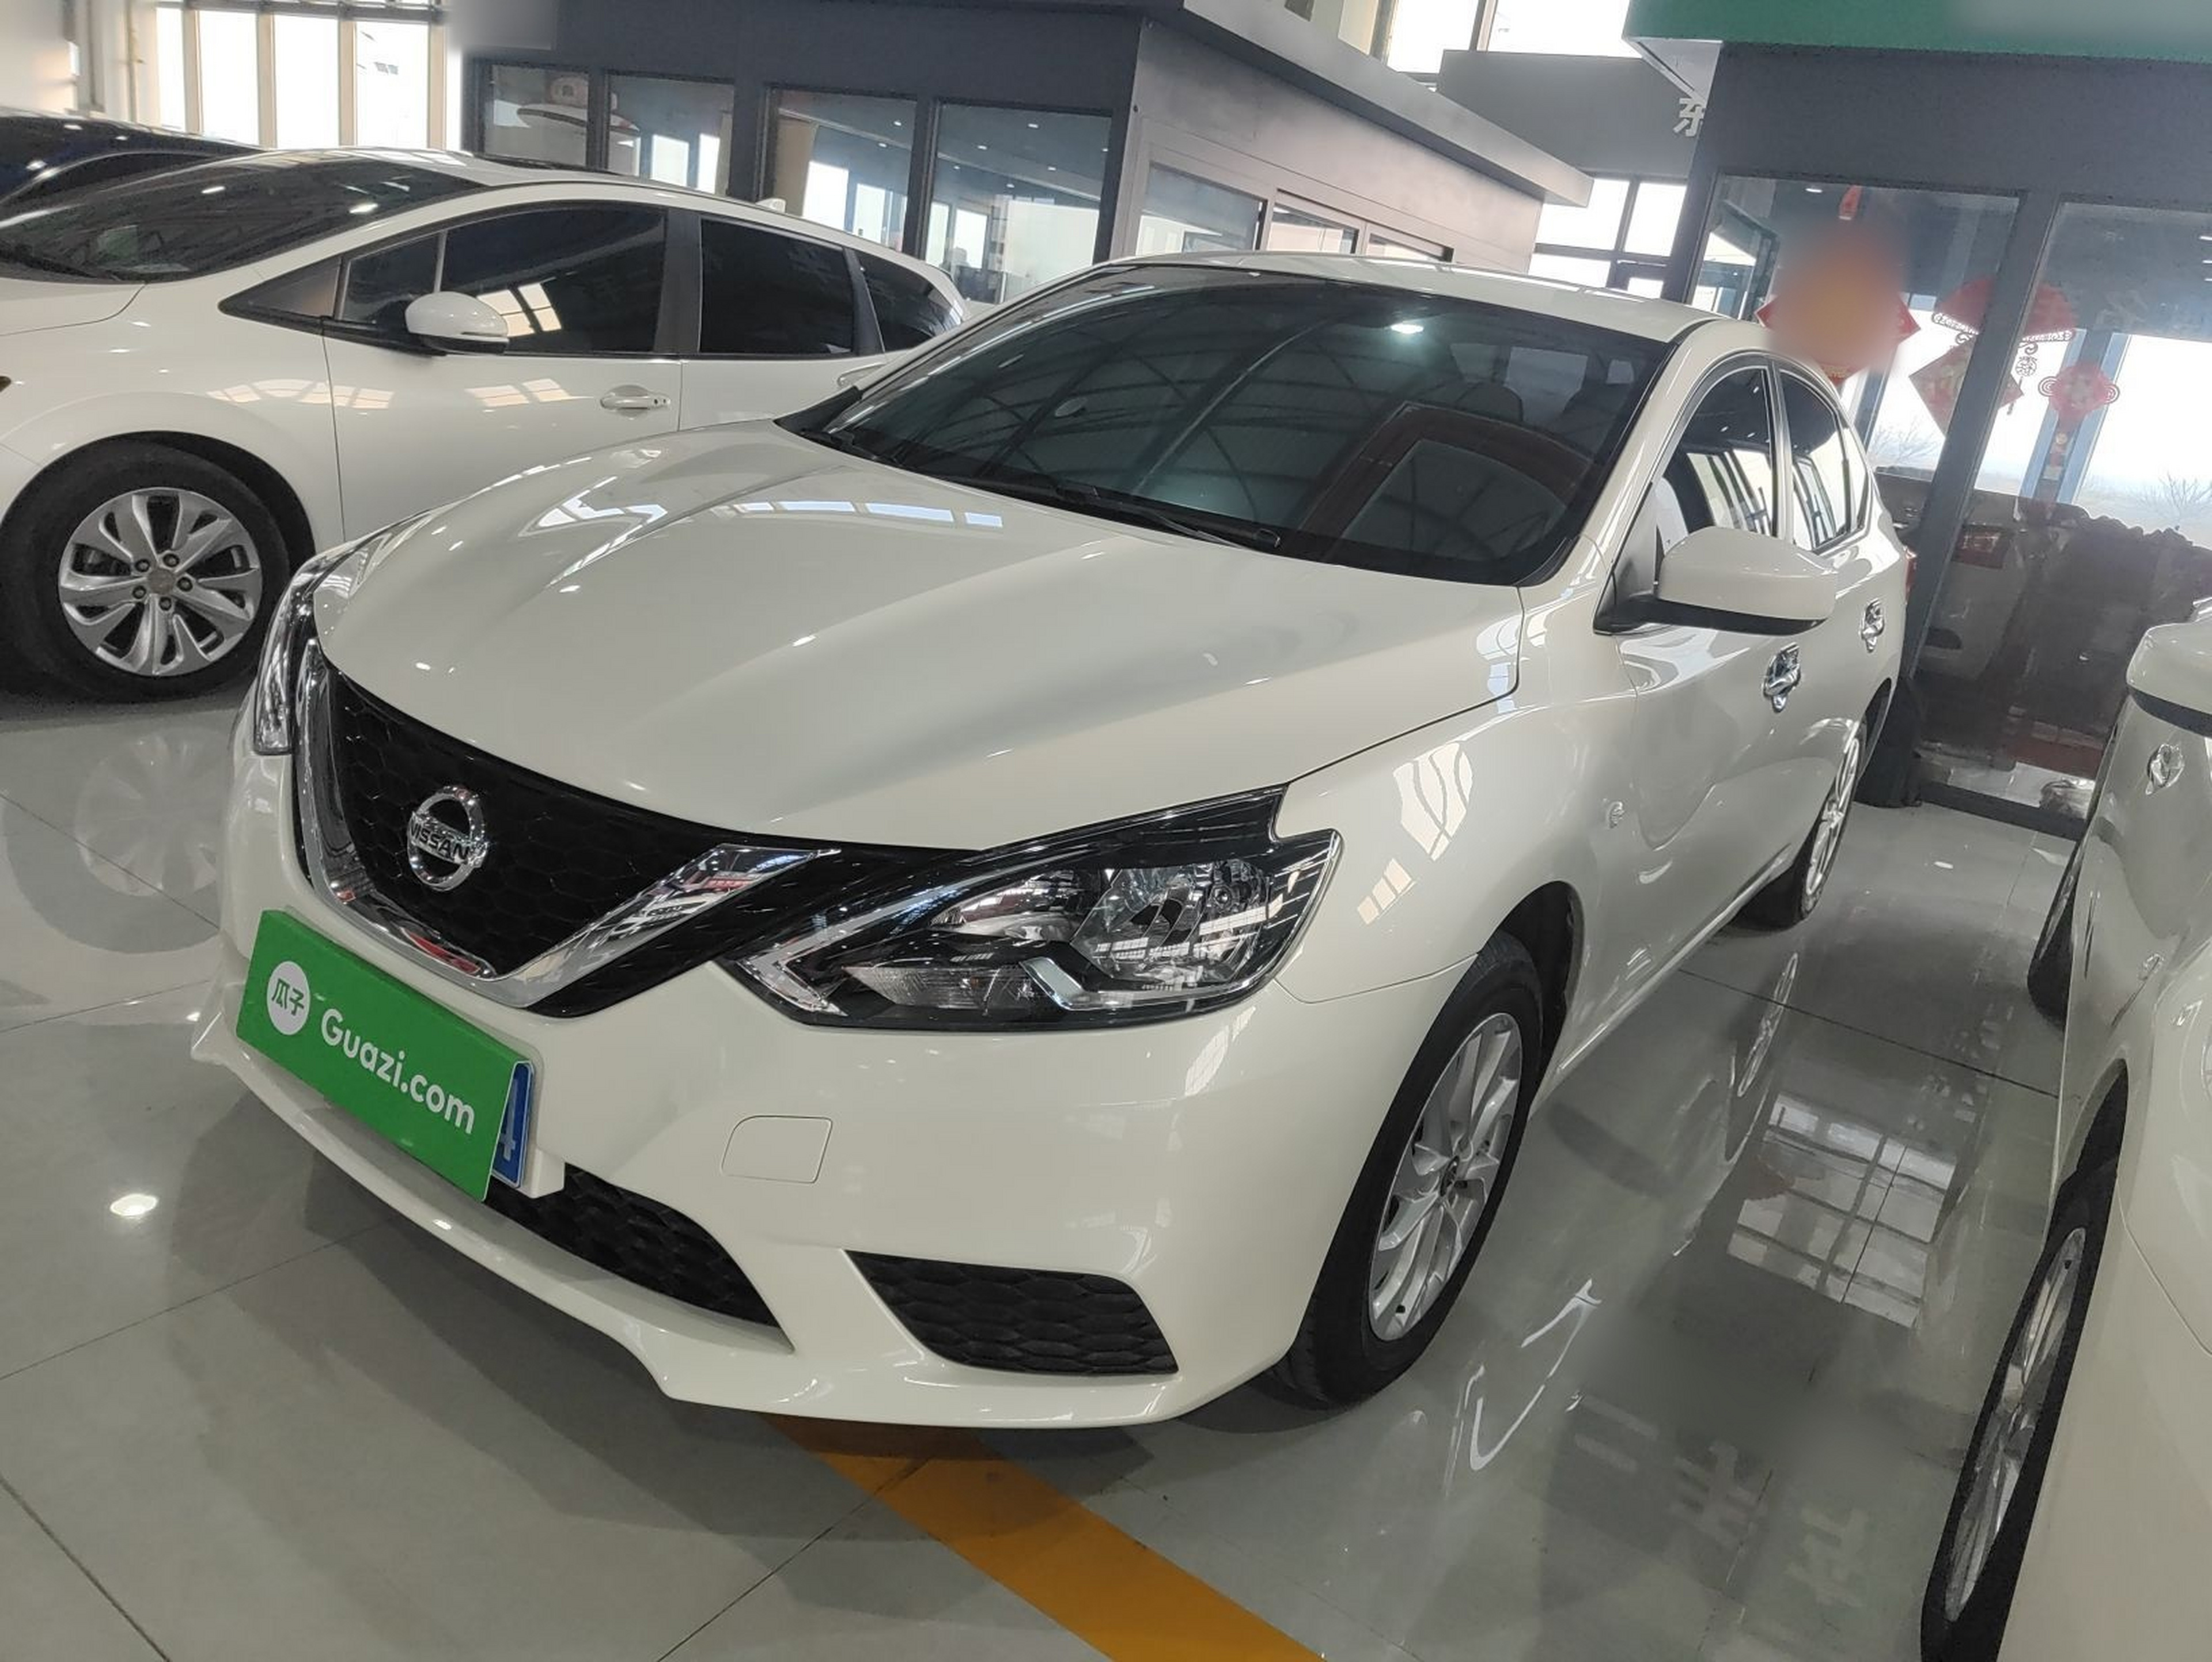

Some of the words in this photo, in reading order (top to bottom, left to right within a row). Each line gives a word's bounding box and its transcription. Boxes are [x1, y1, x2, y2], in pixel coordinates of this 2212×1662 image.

[409, 817, 472, 862] NISSAN
[271, 978, 305, 1016] 瓜子
[321, 1008, 476, 1134] Guazi.com
